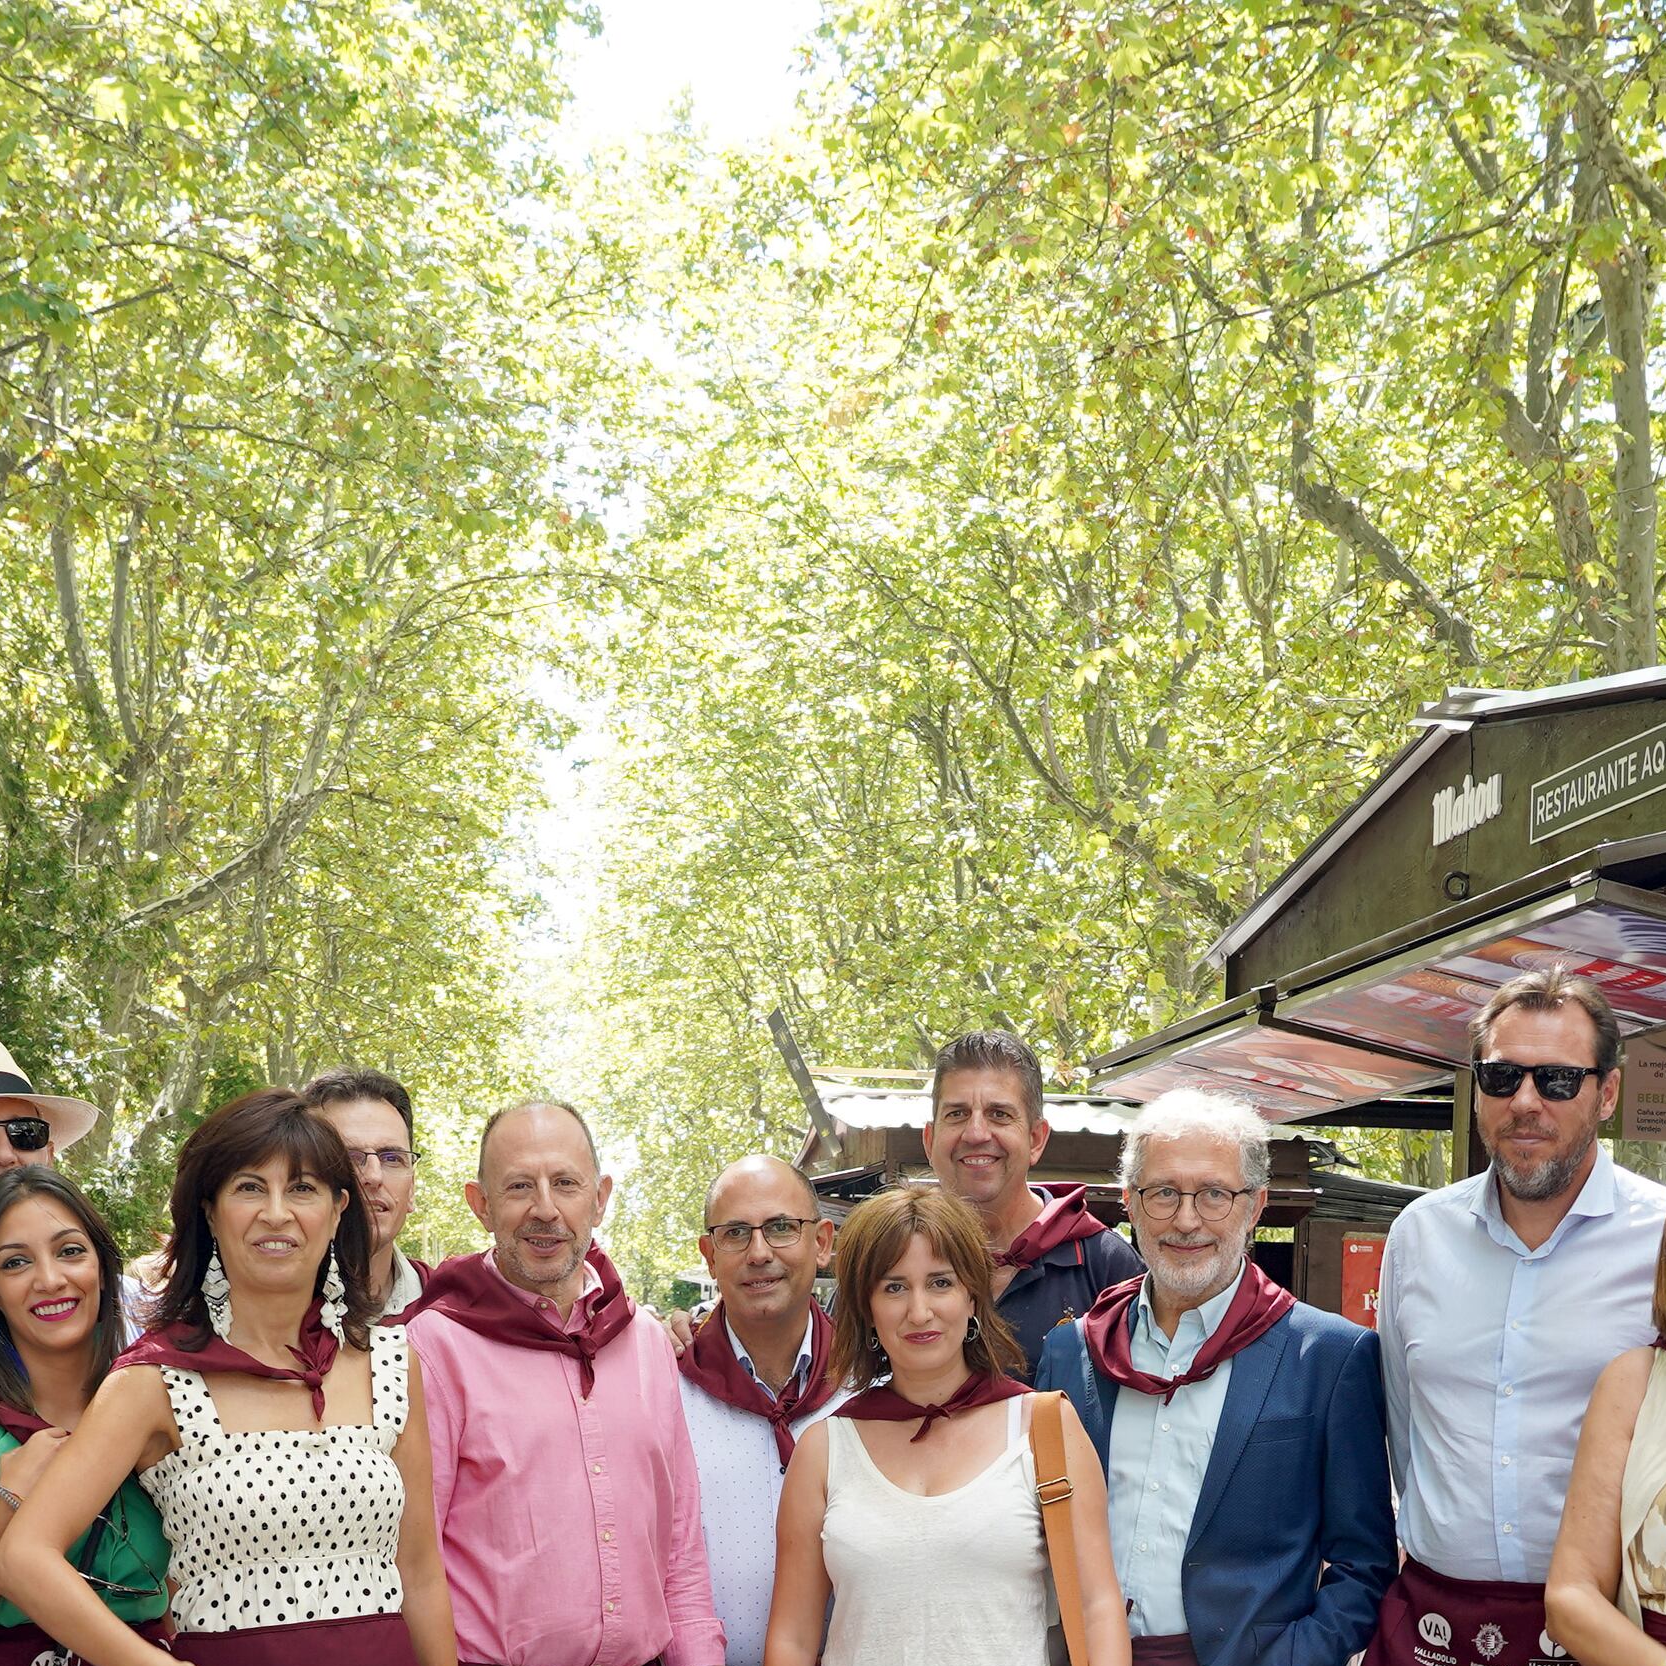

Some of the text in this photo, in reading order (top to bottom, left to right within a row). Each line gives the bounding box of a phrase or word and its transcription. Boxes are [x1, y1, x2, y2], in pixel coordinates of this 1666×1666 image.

[1433, 773, 1503, 846] Mahou
[1536, 752, 1637, 825] RESTAURANTE
[1423, 1619, 1447, 1640] VA!
[1414, 1646, 1457, 1665] VALLADOLID
